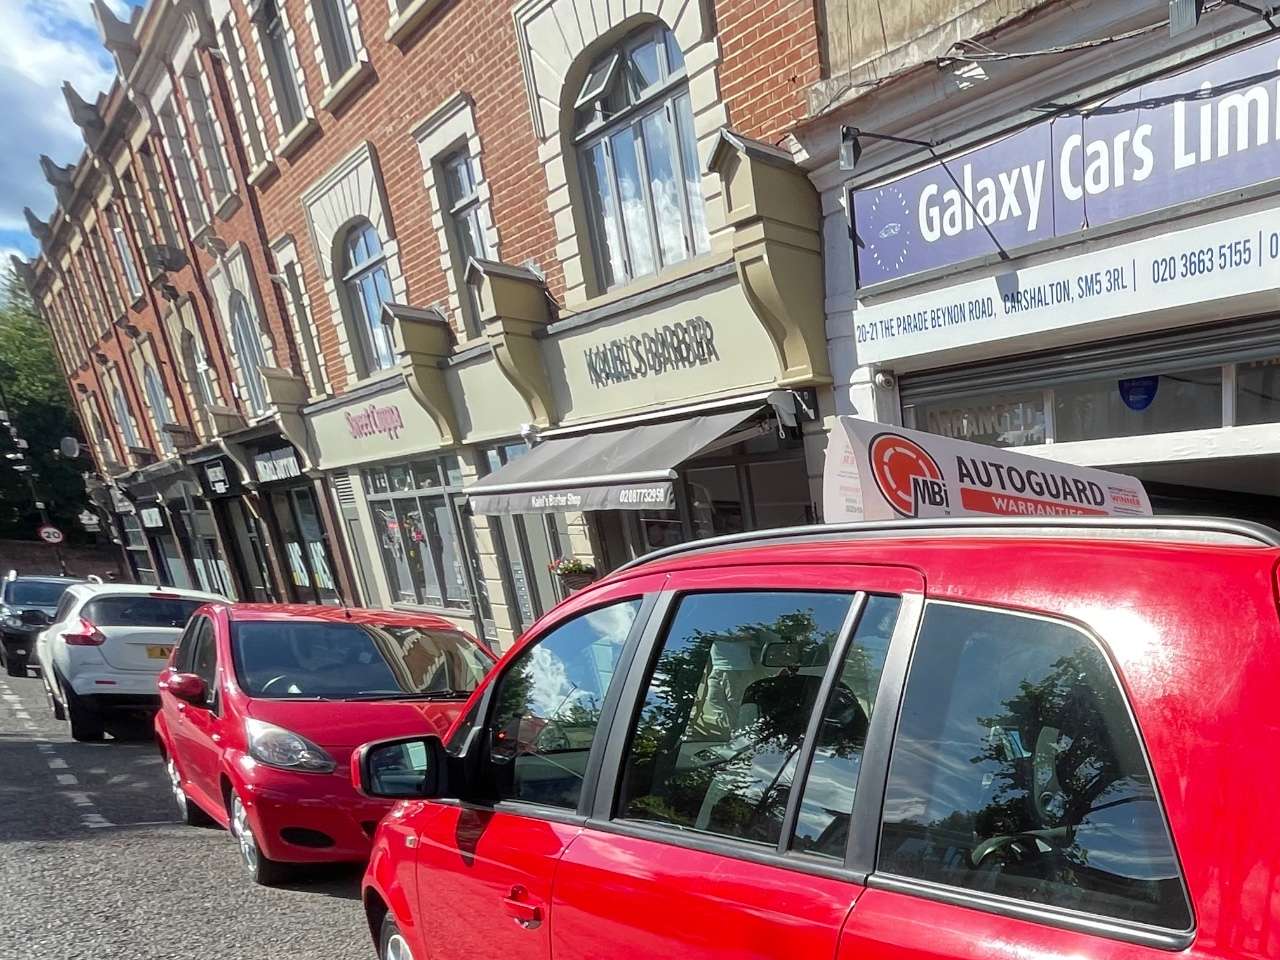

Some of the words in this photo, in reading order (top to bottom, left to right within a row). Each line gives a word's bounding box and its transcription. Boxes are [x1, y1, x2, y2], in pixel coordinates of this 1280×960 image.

[918, 158, 1046, 243] Galaxy
[1059, 123, 1155, 202] Cars
[856, 323, 879, 344] 20-21
[879, 318, 895, 338] THE
[896, 310, 929, 335] PARADE
[930, 305, 967, 328] BEYNON
[969, 297, 998, 320] ROAD,
[1003, 282, 1075, 315] CARSHALTON,
[1077, 272, 1102, 299] SM5
[1104, 266, 1128, 293] 3RL
[1152, 259, 1176, 284] 020
[1180, 248, 1214, 277] 3663
[1218, 239, 1252, 270] 5155
[956, 455, 1105, 507] AUTOGUARD
[43, 530, 61, 540] 20
